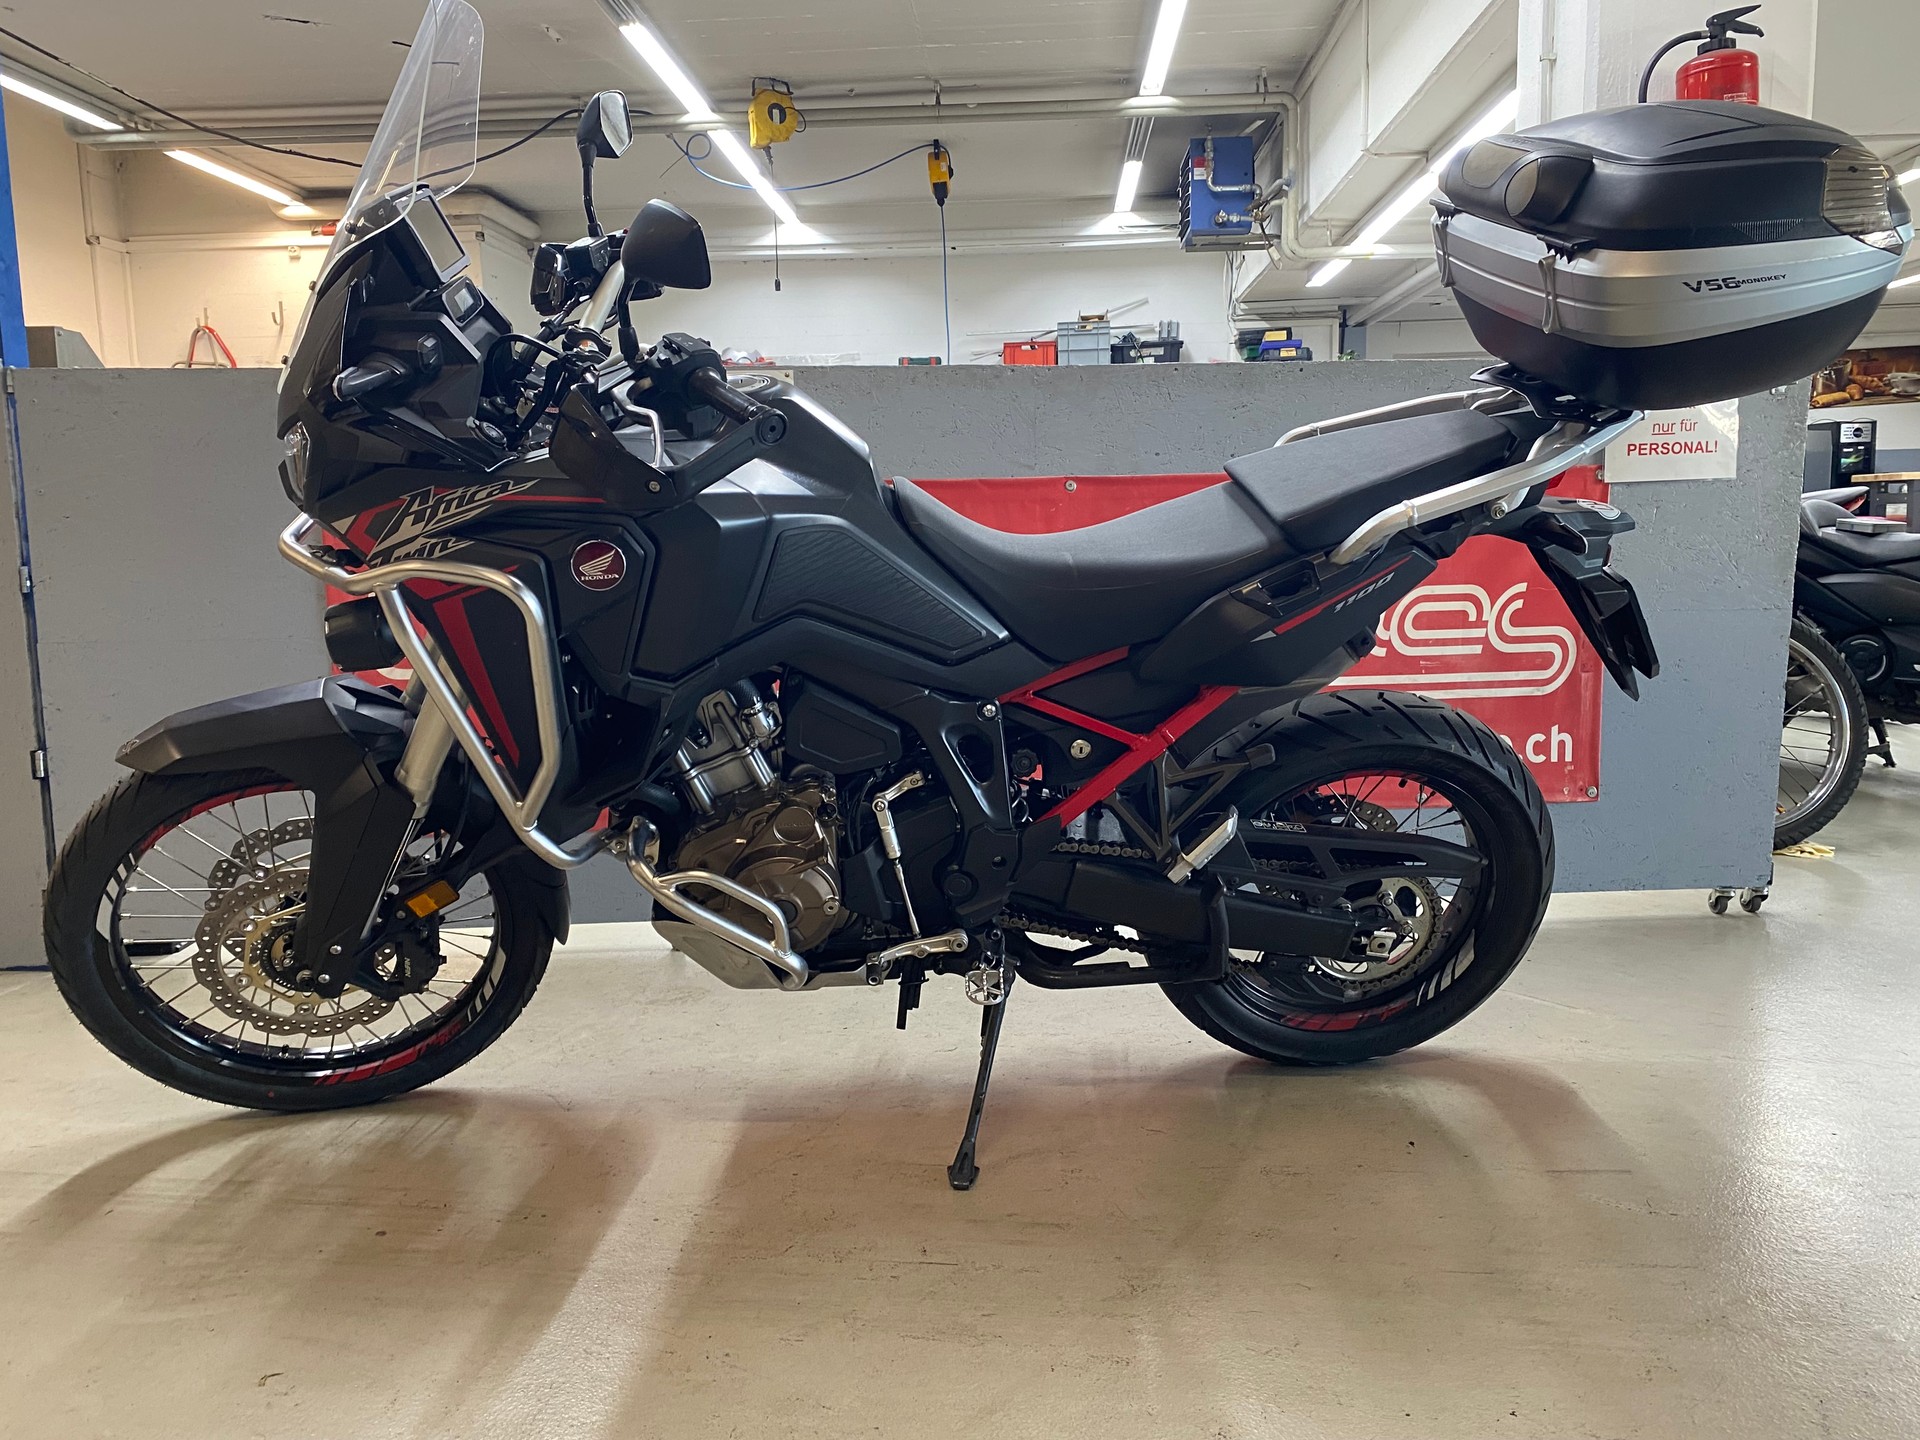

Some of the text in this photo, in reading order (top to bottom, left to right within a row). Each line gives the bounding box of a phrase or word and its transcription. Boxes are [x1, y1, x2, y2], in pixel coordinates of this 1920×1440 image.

[1682, 273, 1787, 293] V56 MONOKEY
[1652, 418, 1698, 435] nur für
[1627, 440, 1718, 456] PERSONAL!
[373, 478, 541, 550] Africa
[580, 573, 620, 581] HONDA
[1333, 571, 1395, 613] 1100
